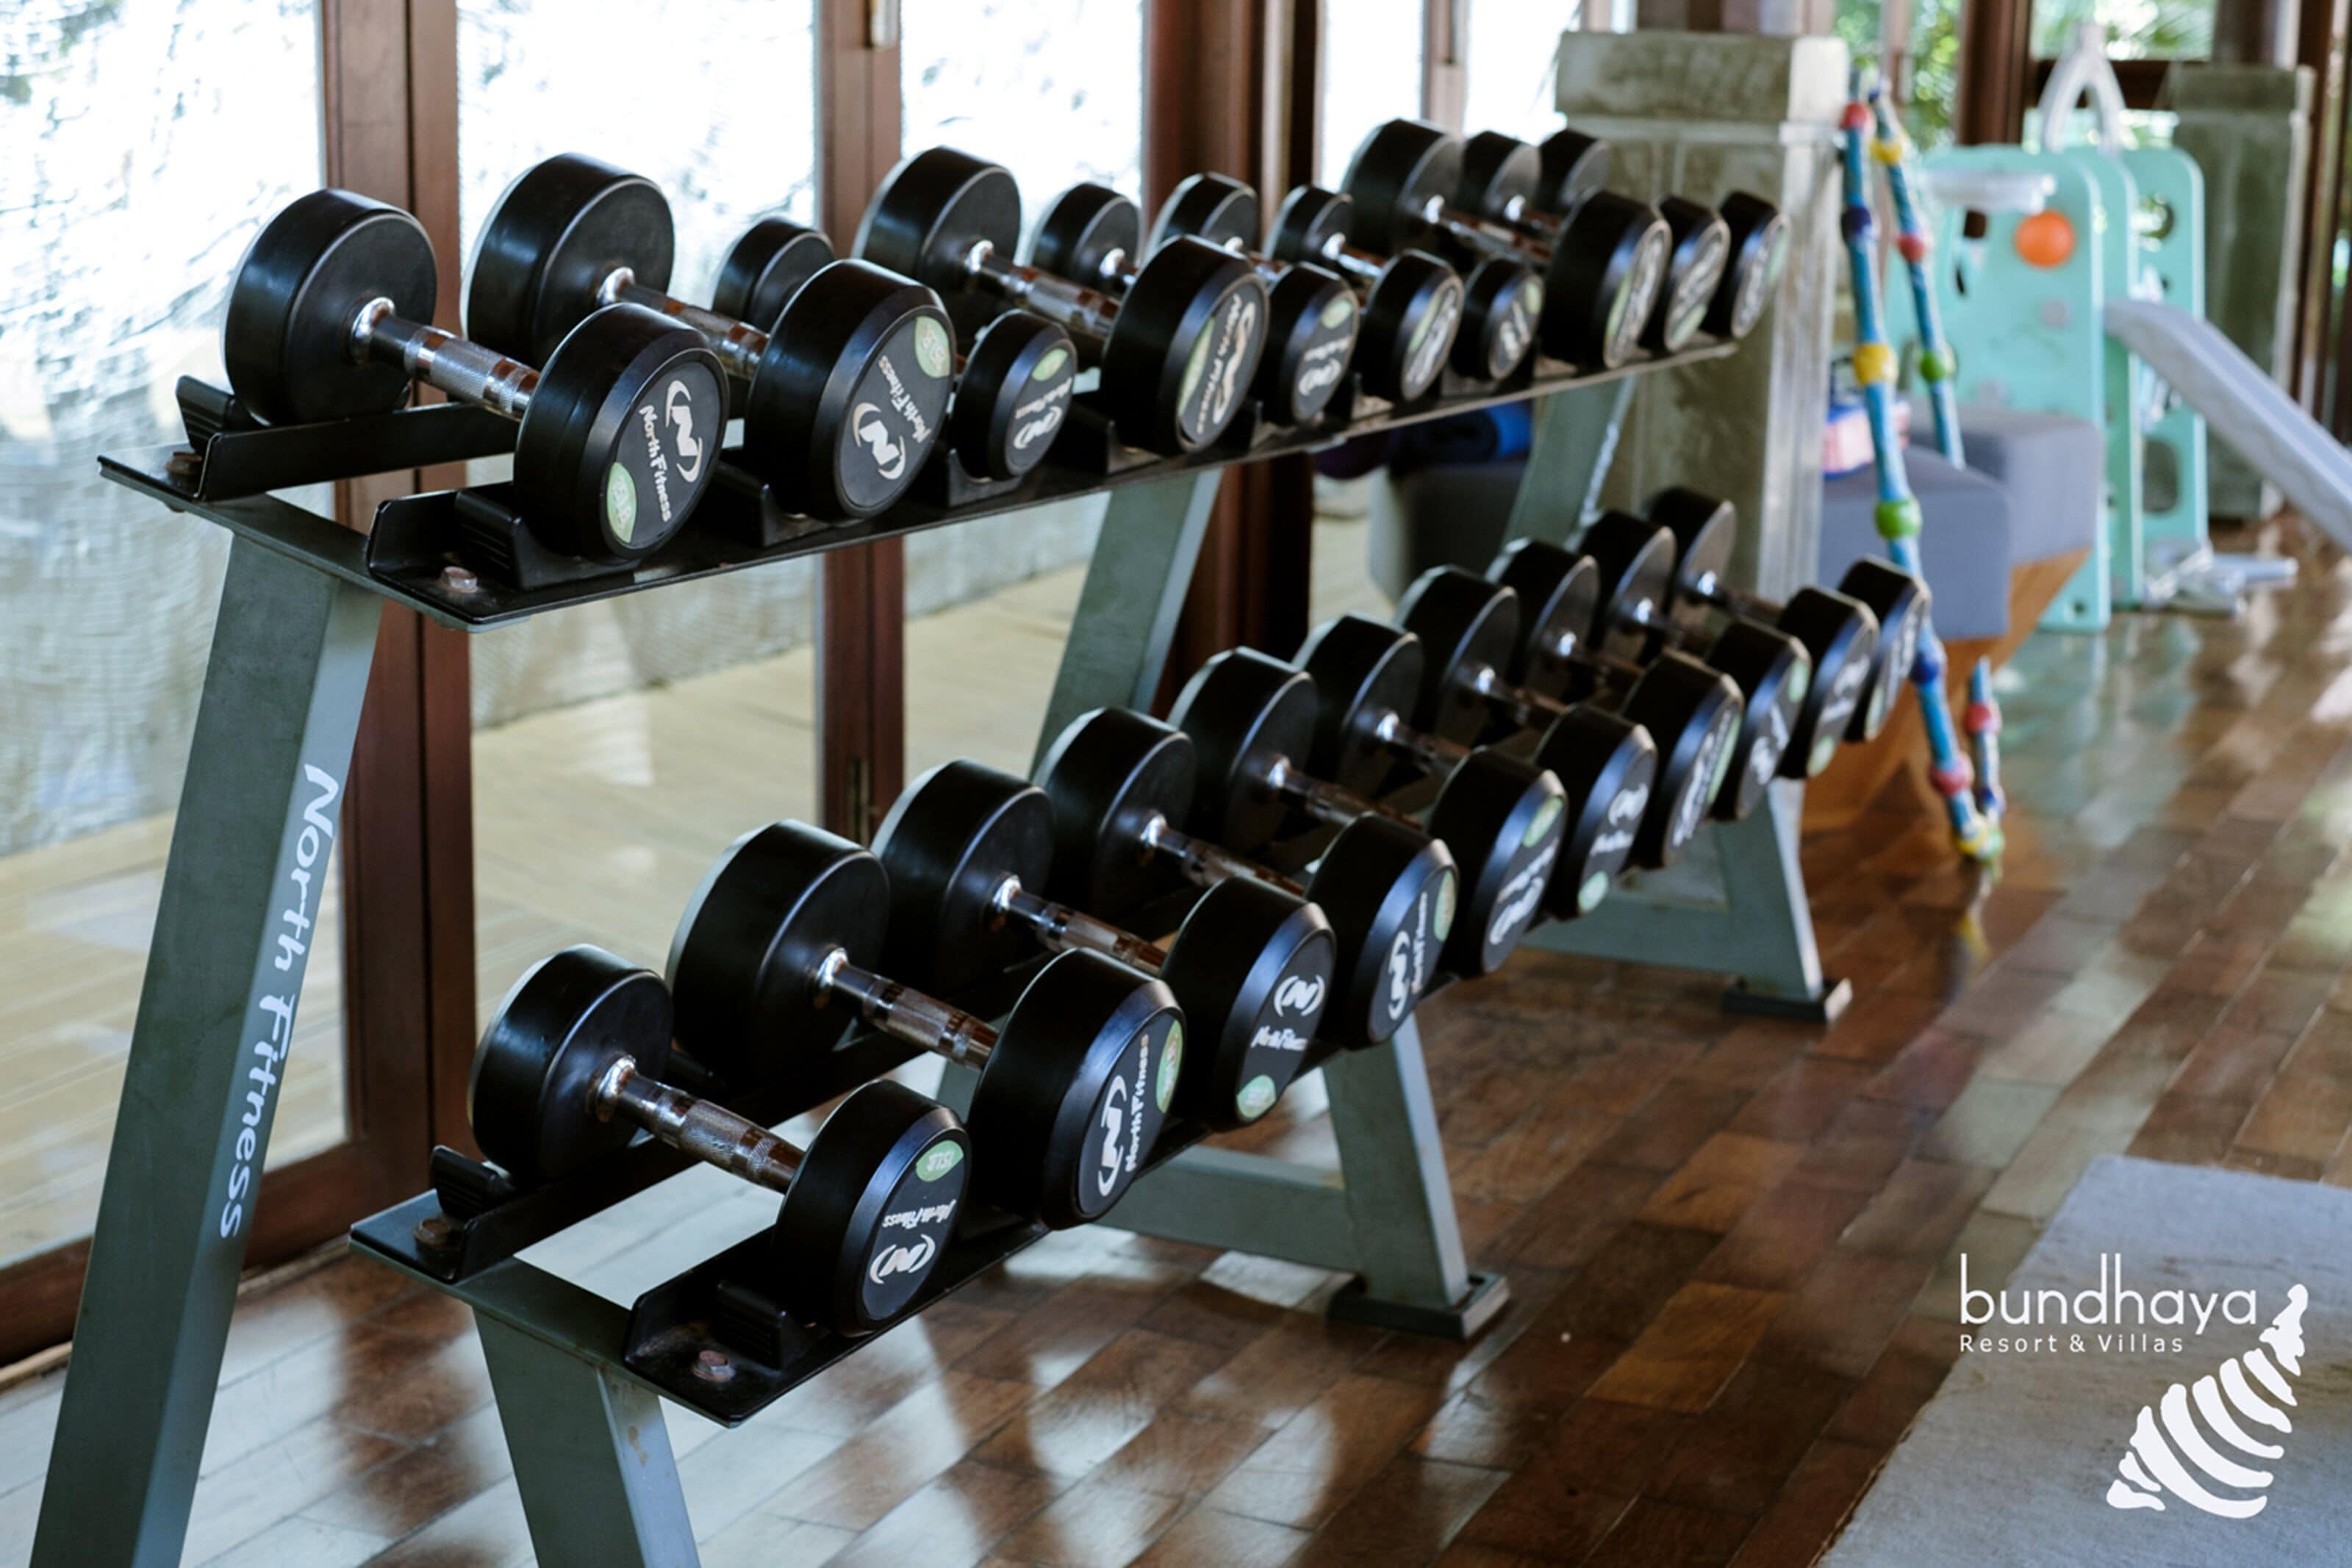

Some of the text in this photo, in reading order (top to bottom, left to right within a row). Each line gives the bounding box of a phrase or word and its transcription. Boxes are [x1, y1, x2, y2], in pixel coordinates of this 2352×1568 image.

[878, 355, 932, 443] North Fitness
[639, 405, 672, 522] North Fitness
[219, 763, 340, 1239] North Fitness
